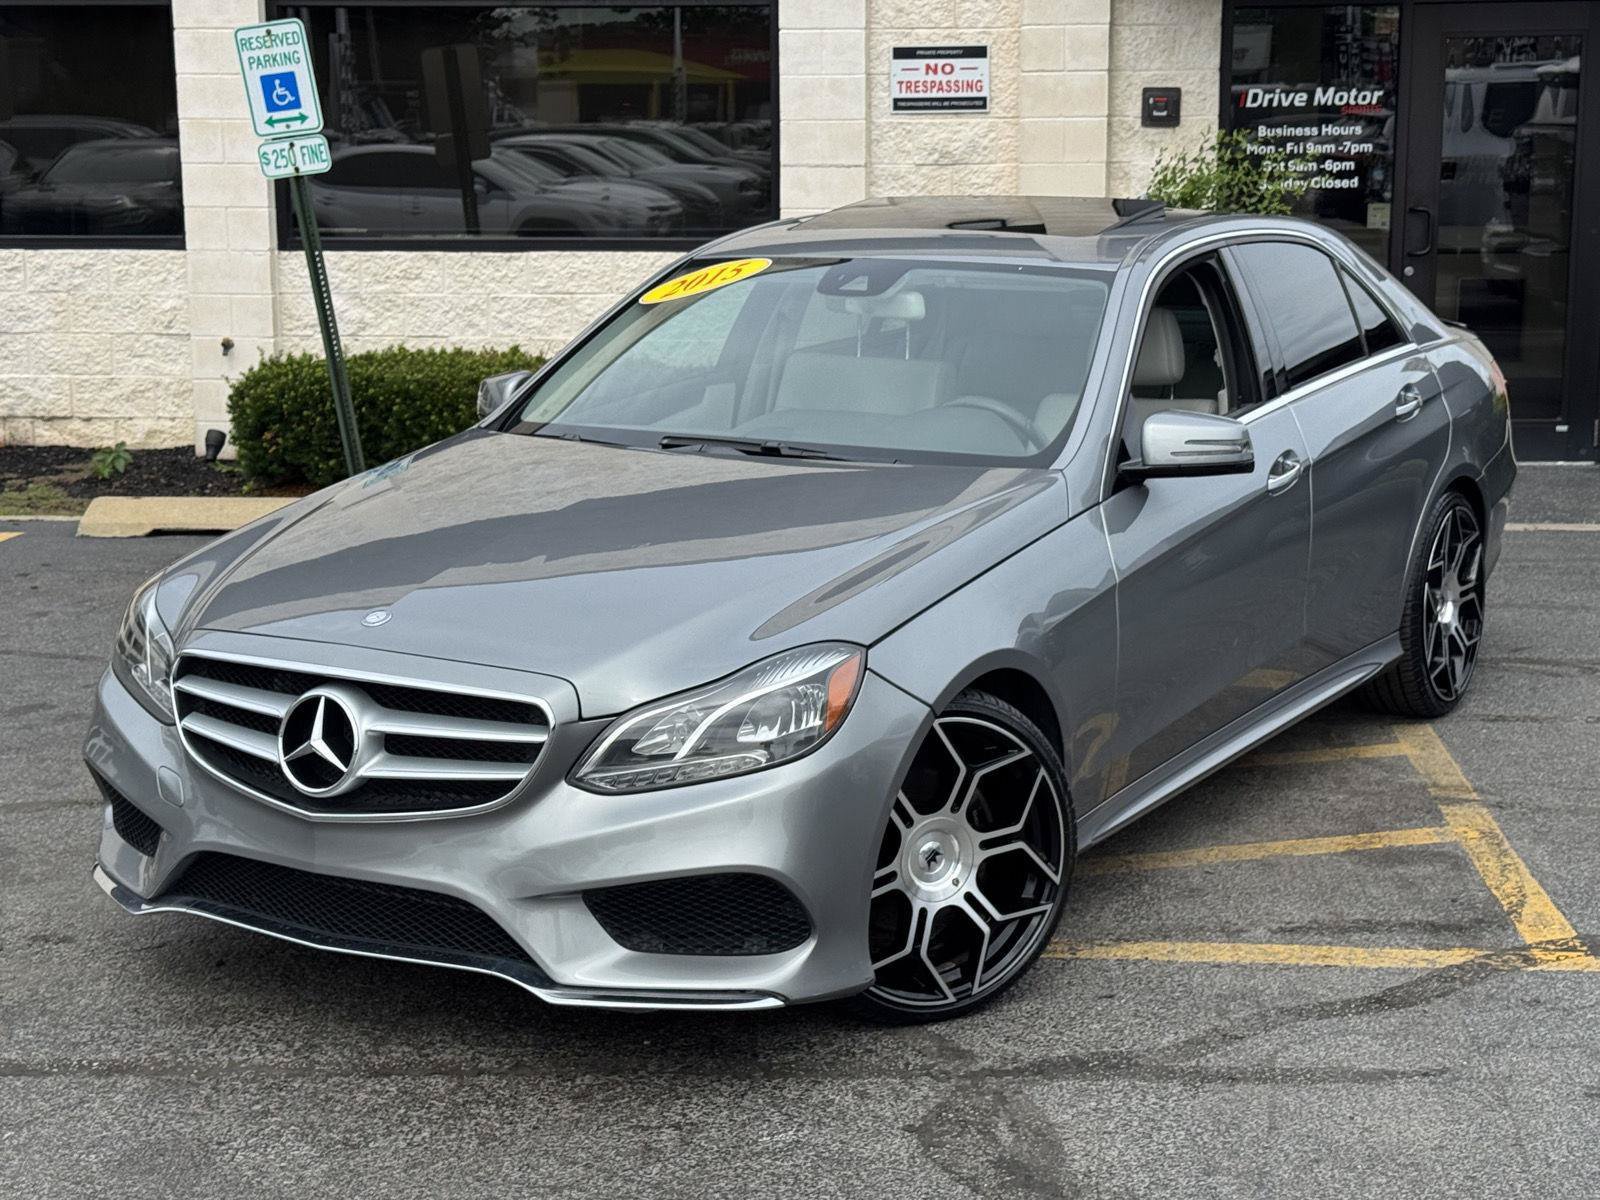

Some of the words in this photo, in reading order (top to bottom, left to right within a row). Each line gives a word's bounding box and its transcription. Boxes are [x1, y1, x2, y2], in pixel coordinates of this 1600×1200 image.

[239, 31, 301, 51] RESERVED
[248, 50, 301, 70] PARKING
[924, 63, 955, 75] NO
[897, 80, 983, 94] TRESPASSING
[1313, 87, 1384, 106] Motor
[1257, 125, 1318, 138] Business
[1321, 124, 1362, 136] Hours
[261, 145, 298, 169] $250
[301, 143, 328, 165] FINE
[1246, 143, 1275, 155] Mon
[1286, 142, 1303, 155] Fri
[1305, 142, 1335, 154] 9am
[1311, 176, 1359, 189] Closed
[660, 262, 751, 299] 2015
